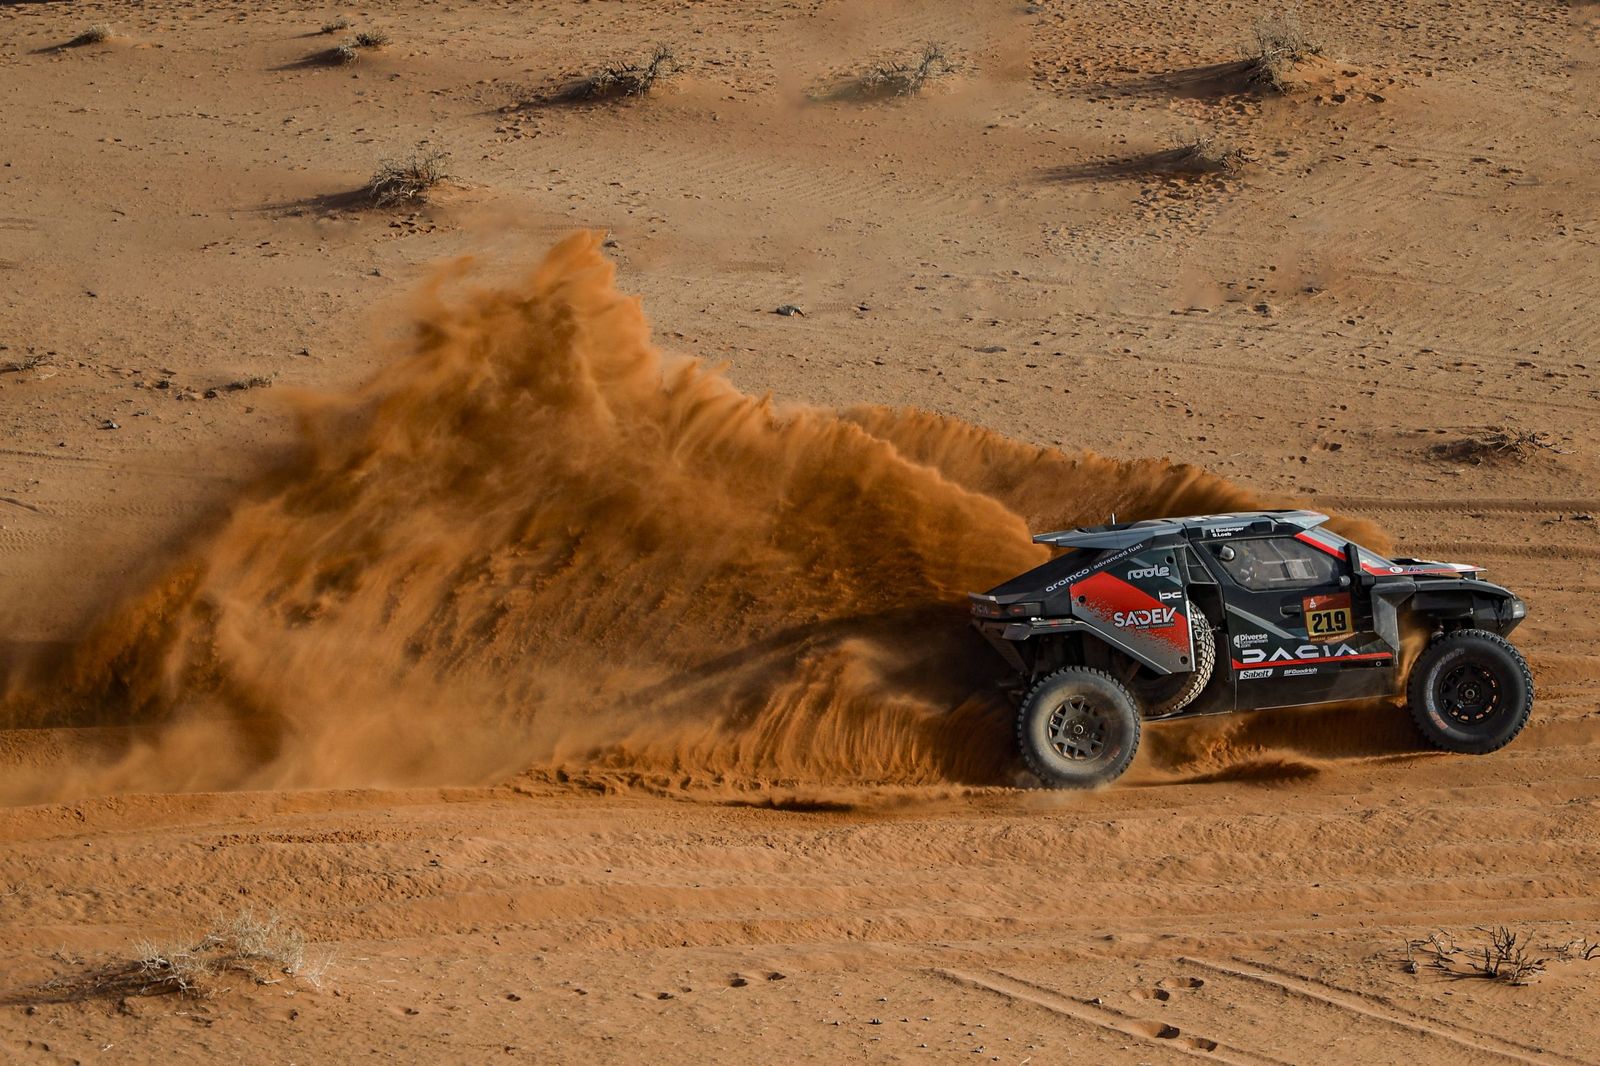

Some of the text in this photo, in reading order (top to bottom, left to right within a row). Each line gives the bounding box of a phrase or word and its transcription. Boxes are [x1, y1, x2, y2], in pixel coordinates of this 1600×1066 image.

[1045, 543, 1144, 593] aramco advanced fuel
[1113, 606, 1177, 629] SADEV
[1311, 610, 1347, 634] 219
[1240, 633, 1268, 642] Diverse
[1242, 643, 1360, 664] DACIA
[1242, 669, 1270, 680] Sabelt
[1283, 667, 1319, 677] BFGoodrich
